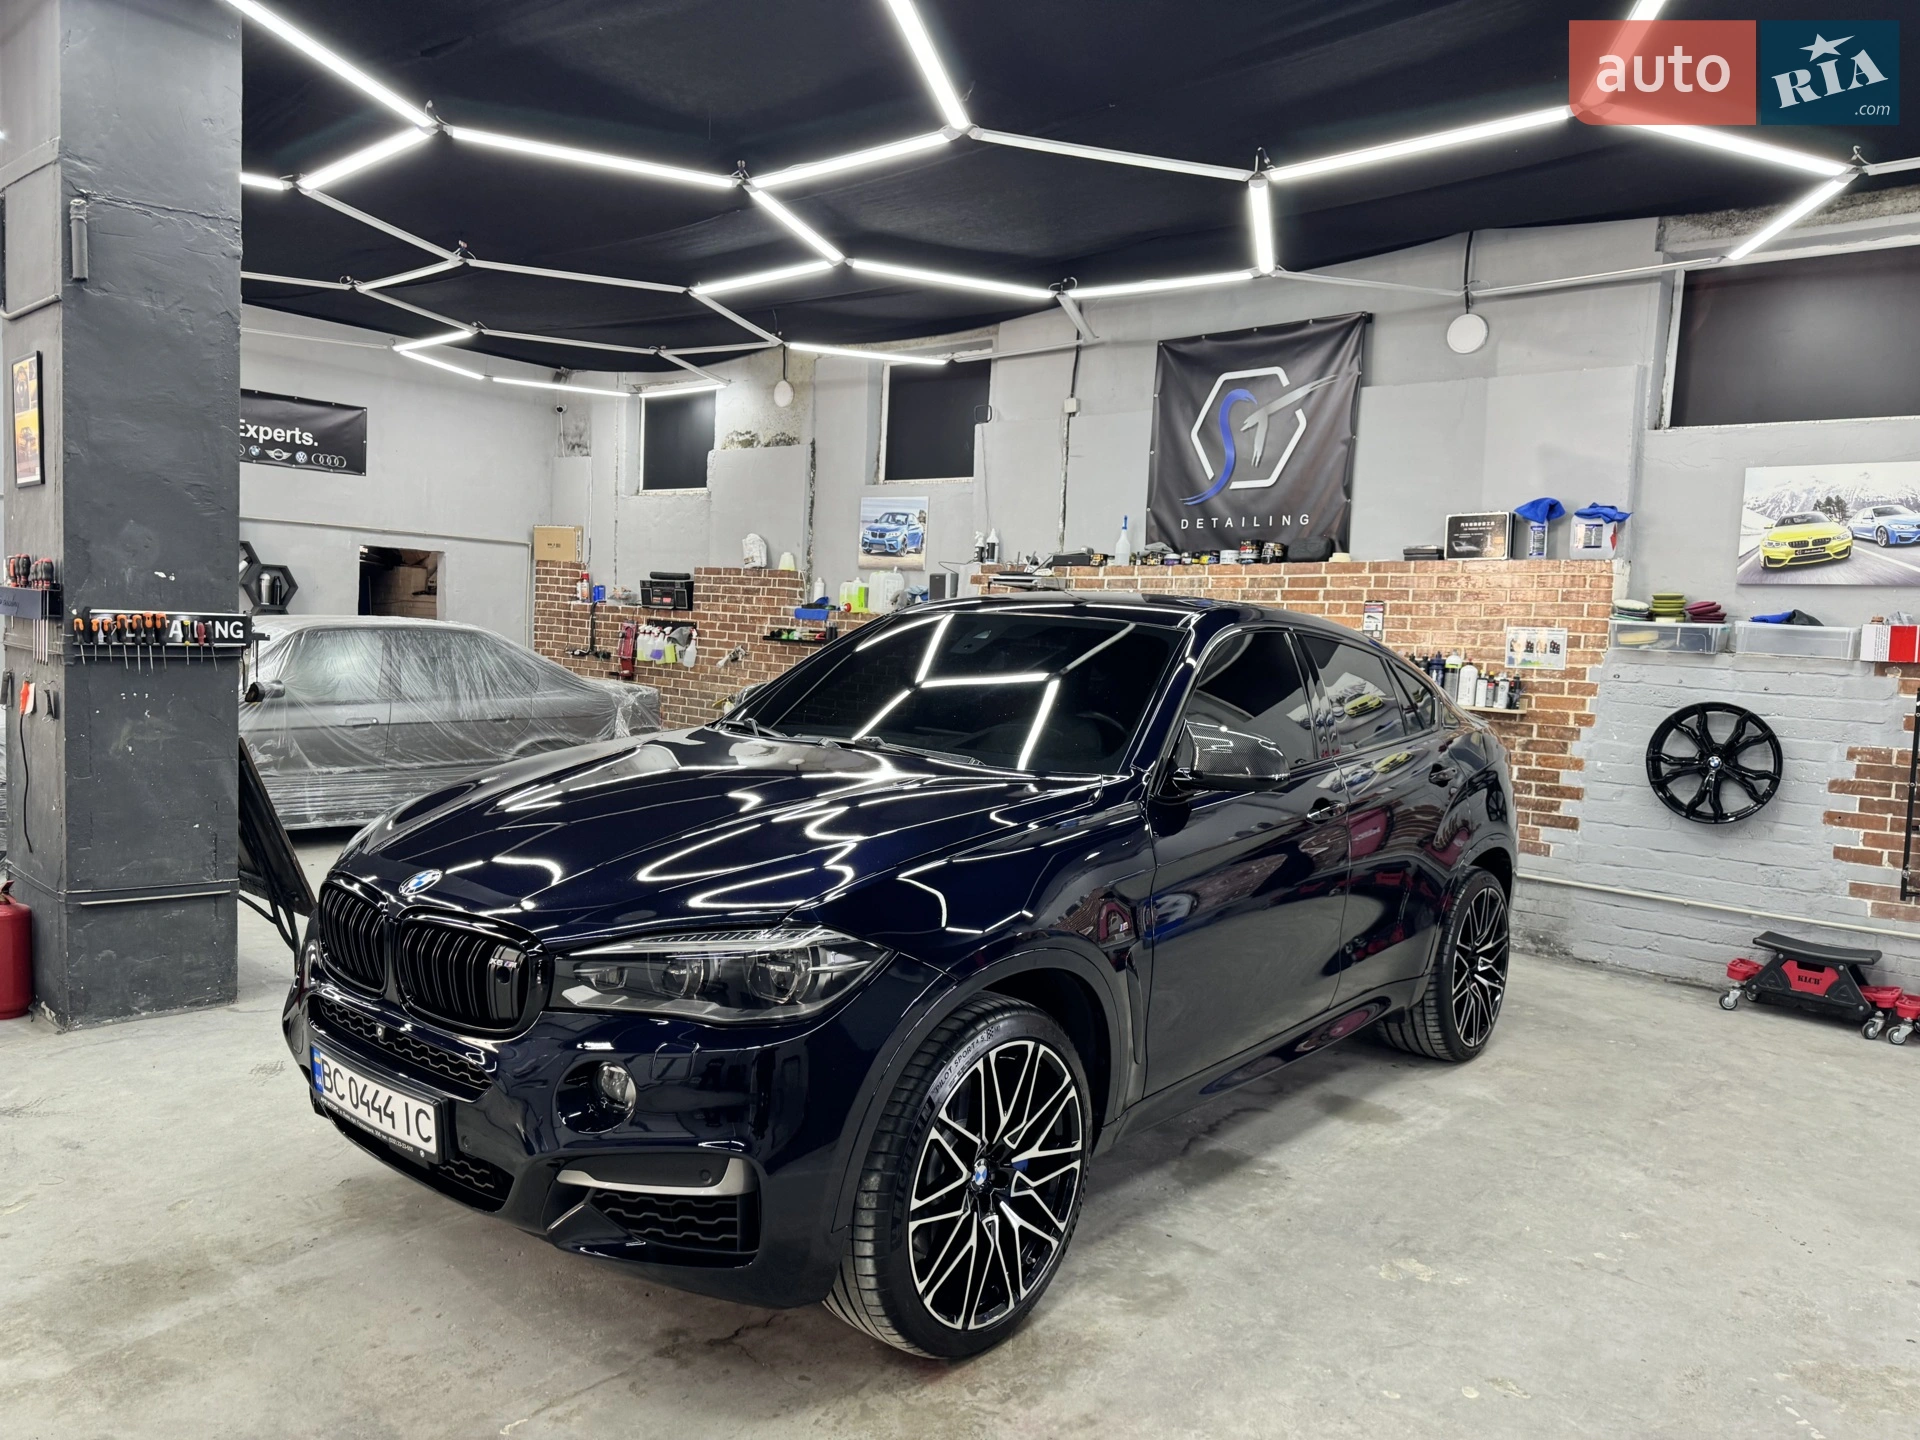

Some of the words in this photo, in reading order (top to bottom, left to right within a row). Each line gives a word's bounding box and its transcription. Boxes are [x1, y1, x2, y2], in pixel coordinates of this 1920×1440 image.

[1180, 513, 1310, 530] DETAILING
[322, 1059, 345, 1101] BC
[348, 1076, 396, 1130] 0444
[404, 1102, 432, 1143] IC
[935, 1065, 954, 1093] PILOT
[954, 1041, 977, 1067] SPORT
[893, 1103, 933, 1219] MICHELIN
